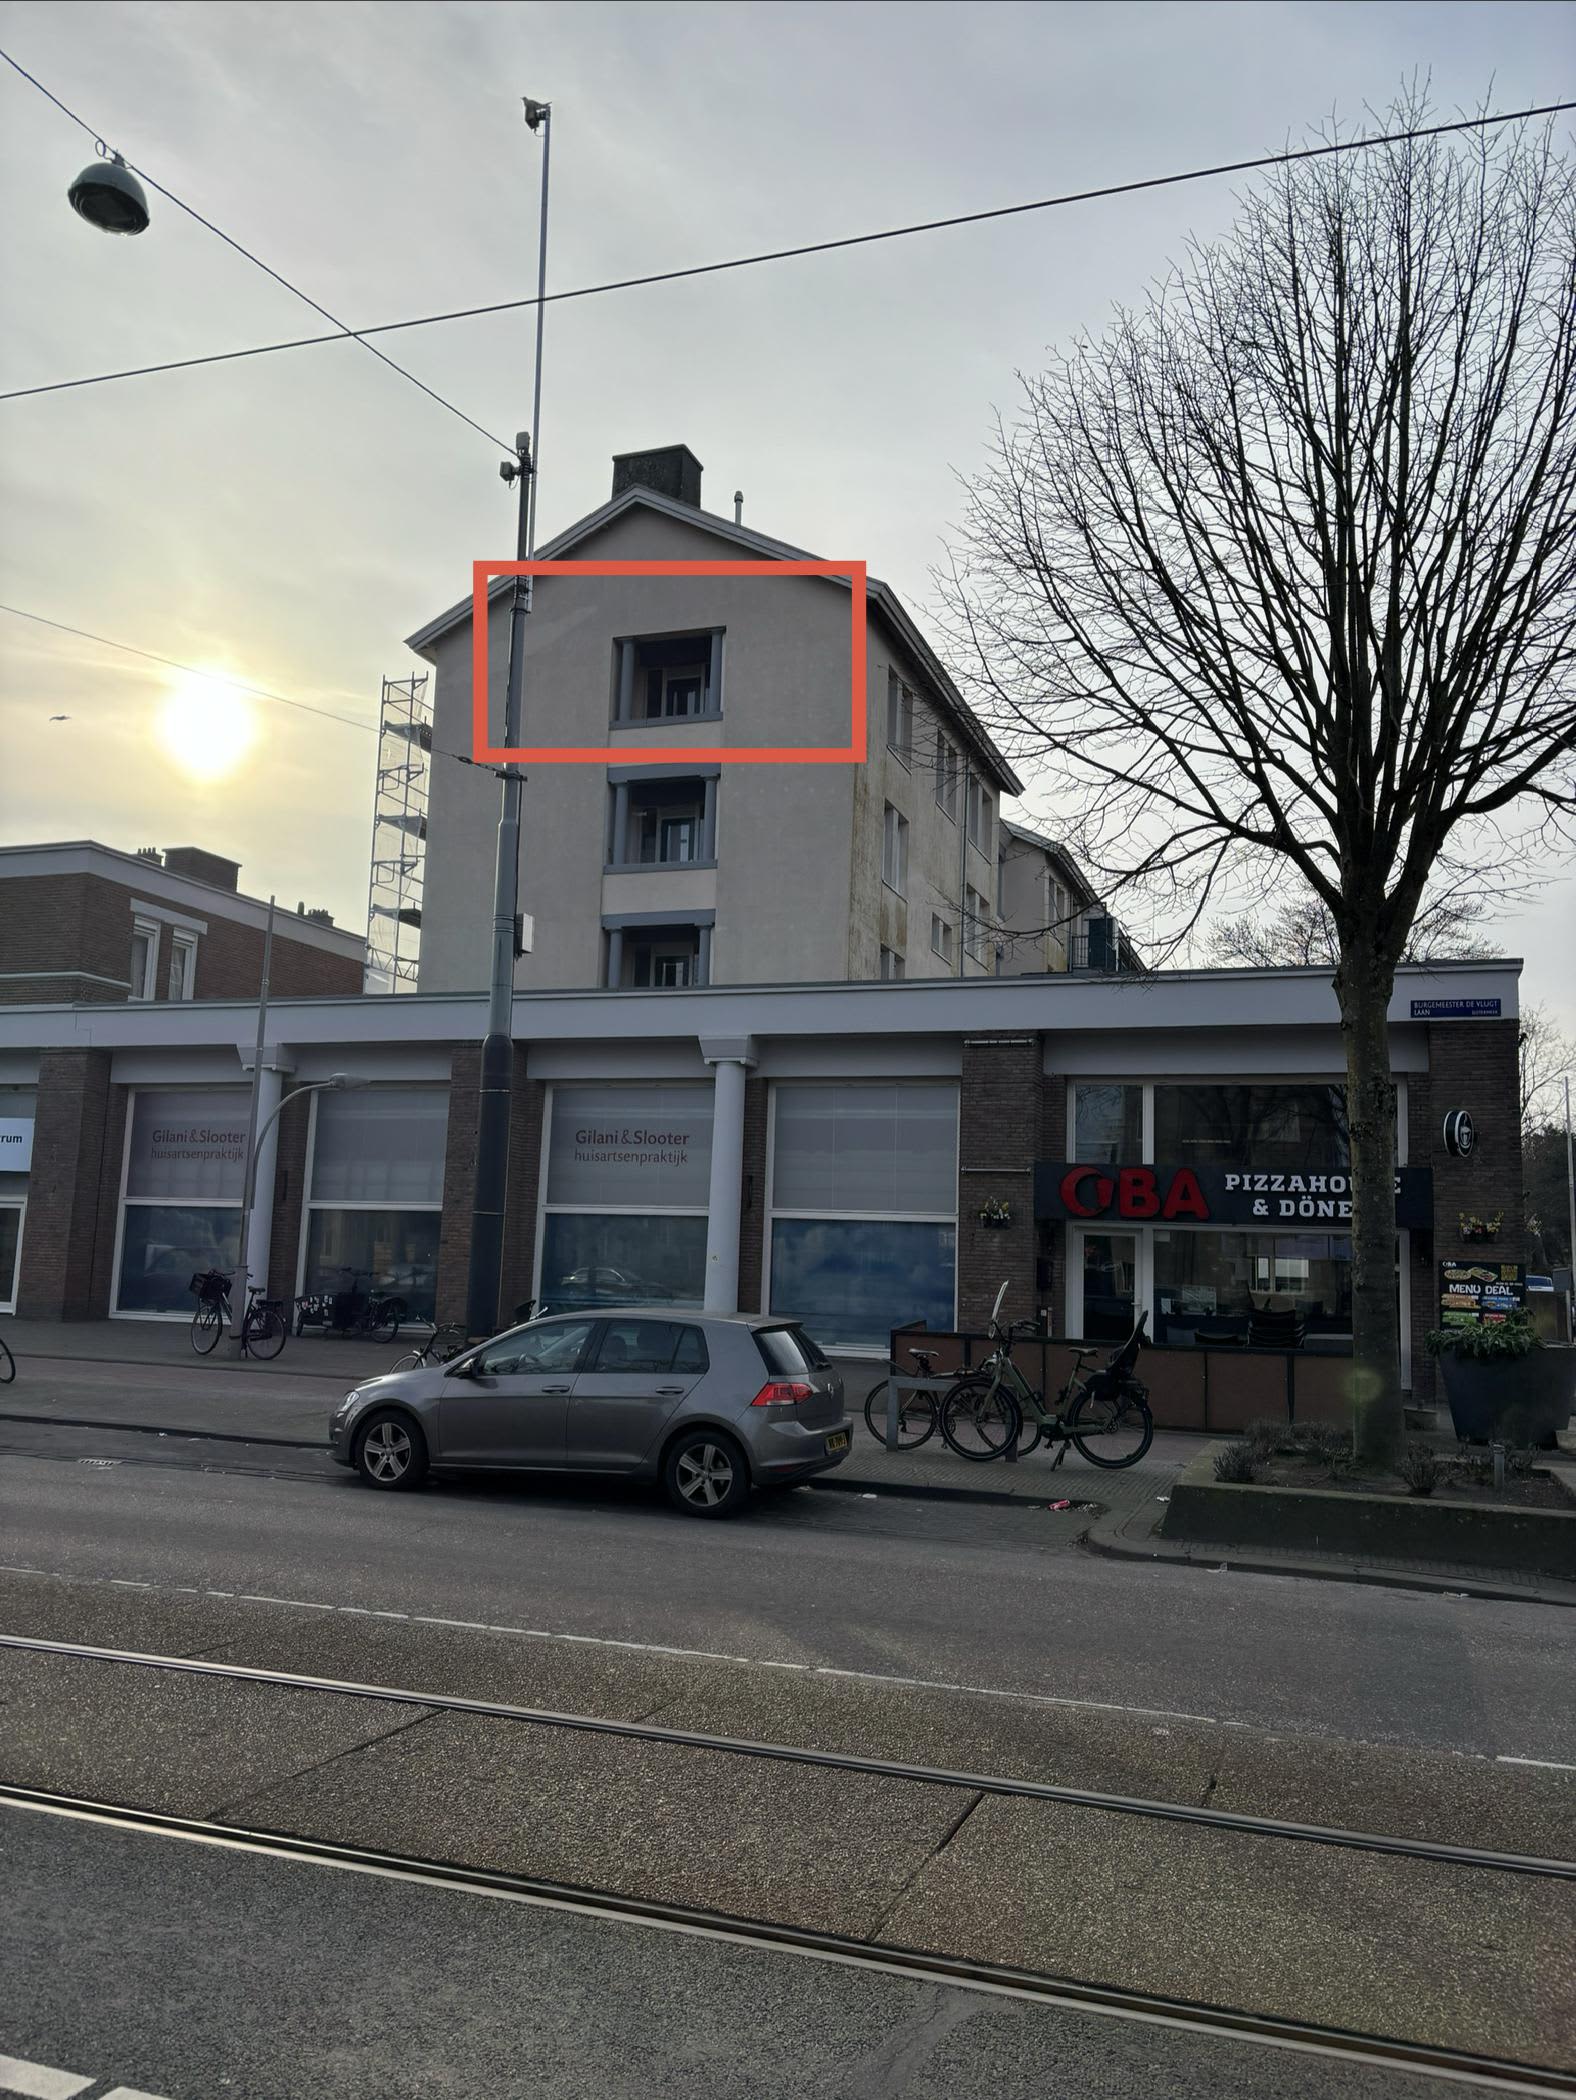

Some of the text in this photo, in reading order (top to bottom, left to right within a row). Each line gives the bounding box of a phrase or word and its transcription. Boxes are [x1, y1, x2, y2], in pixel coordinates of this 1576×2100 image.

[1414, 1001, 1464, 1009] BURGEMEESTER
[1476, 1000, 1498, 1008] VLUGT
[0, 1135, 23, 1144] rum
[152, 1147, 244, 1162] huisartsenpraktijk
[574, 1149, 688, 1166] huisartsenpraktijk
[1225, 1174, 1402, 1194] PIZZAHOE
[1060, 1166, 1210, 1221] OBA
[1252, 1195, 1353, 1218] & DÖNE
[1449, 1284, 1513, 1295] MENU DEAL
